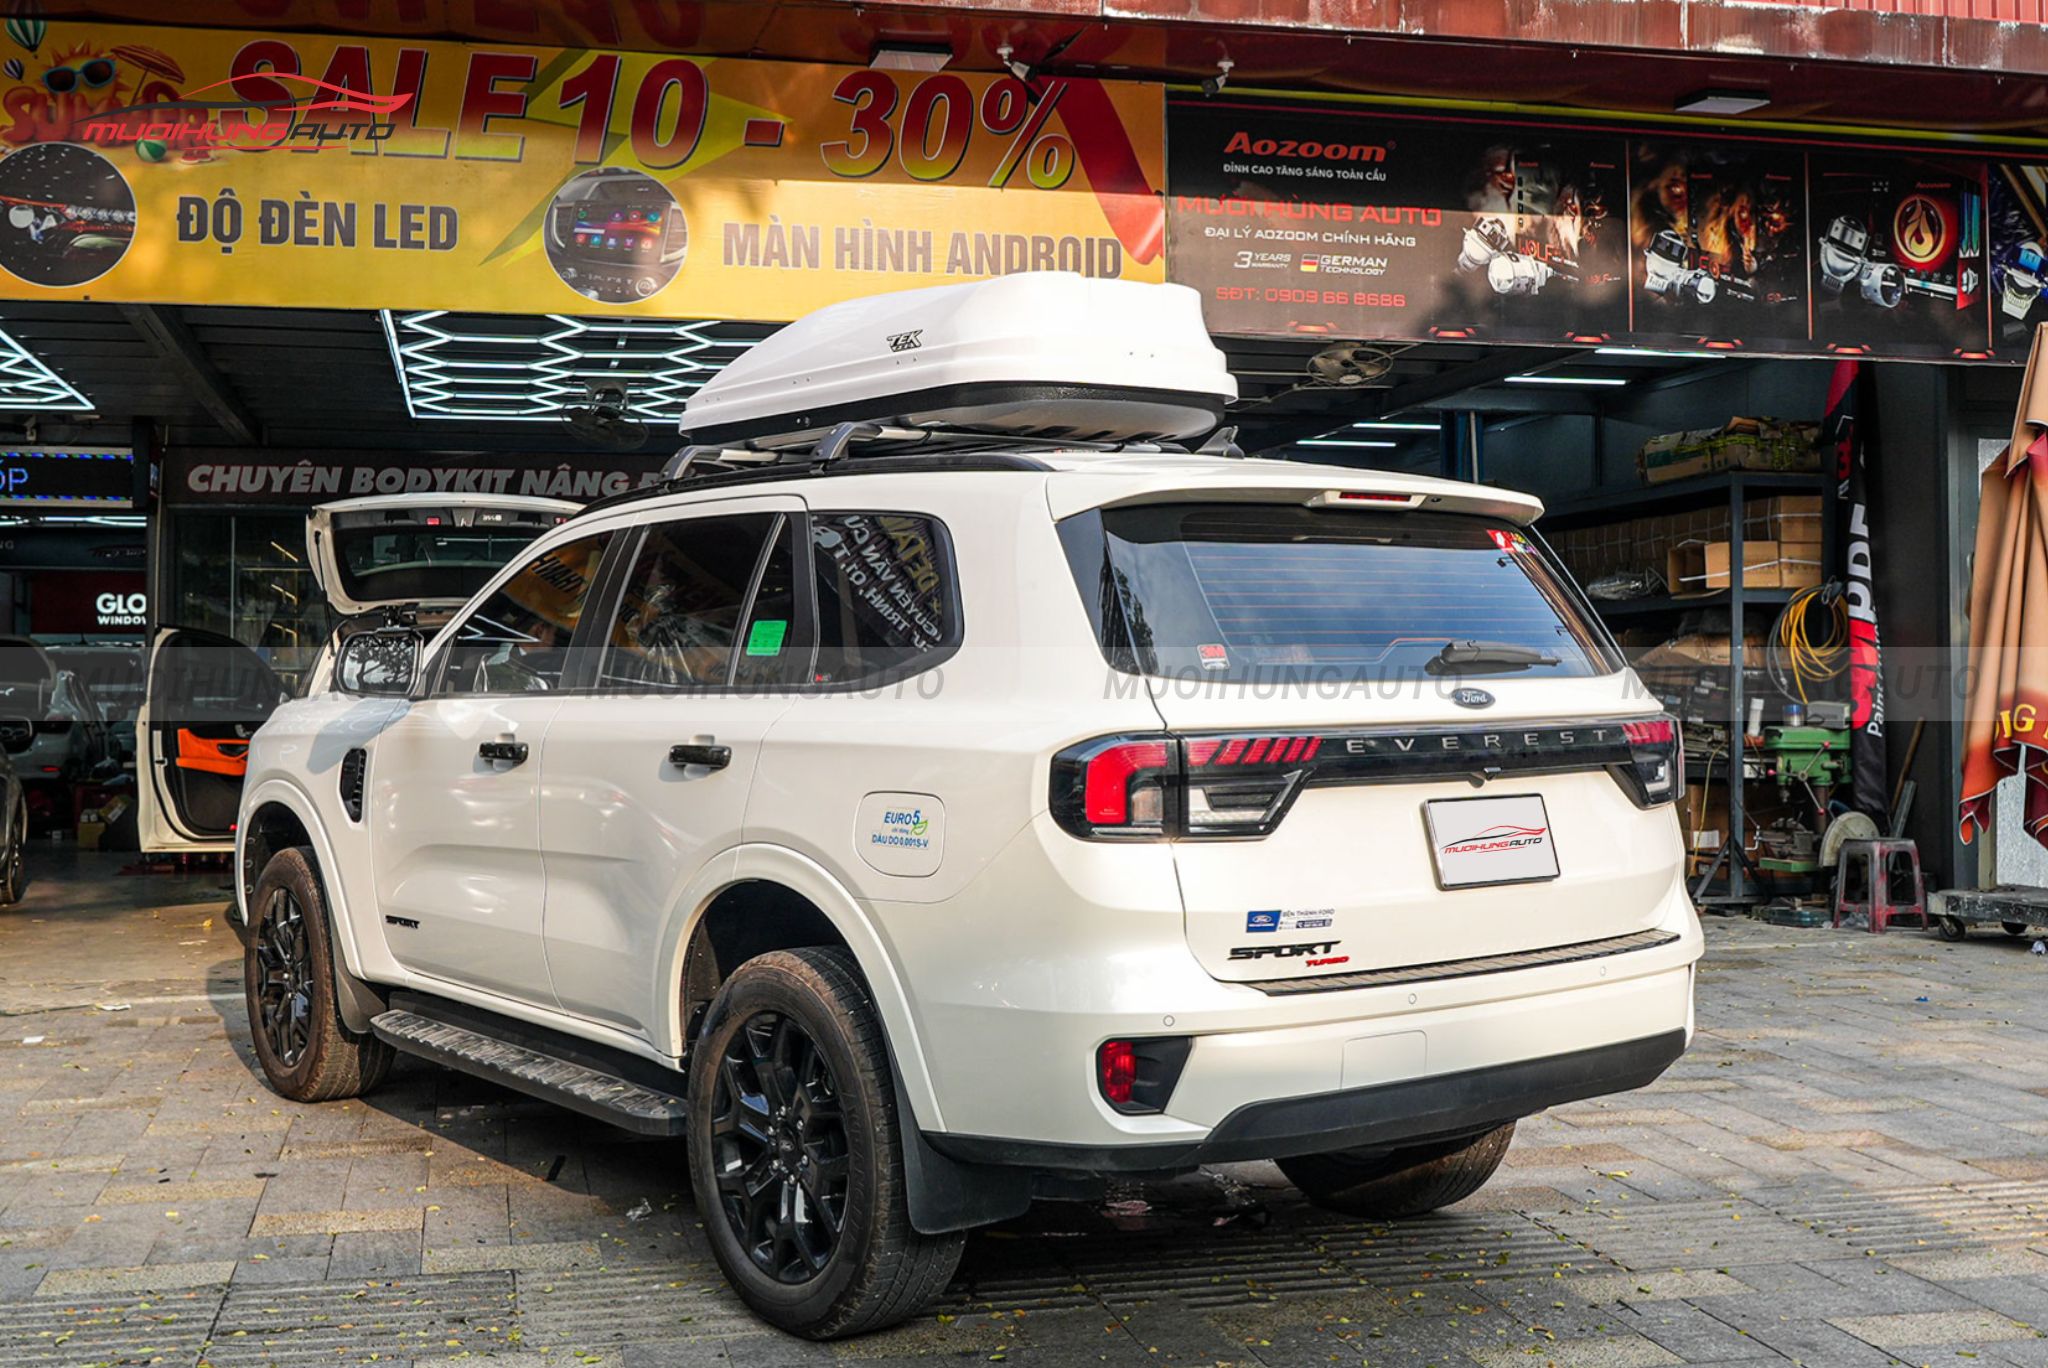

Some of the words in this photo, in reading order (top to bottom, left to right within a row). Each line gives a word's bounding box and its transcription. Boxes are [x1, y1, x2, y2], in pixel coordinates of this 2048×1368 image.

[217, 40, 537, 163] SALE
[556, 54, 710, 171] 10
[820, 70, 1076, 190] 30%
[1223, 131, 1386, 162] Aozoom
[1251, 165, 1273, 175] CAO
[1276, 164, 1303, 177] TĂNG
[1305, 164, 1334, 178] SÁNG
[1336, 167, 1364, 180] TOÀN
[176, 187, 243, 254] ĐỘ
[259, 191, 357, 249] ĐÈN
[372, 203, 459, 252] LED
[1359, 204, 1443, 226] AUTO
[1204, 227, 1230, 240] ĐẠI
[1234, 225, 1251, 239] LÝ
[1254, 230, 1319, 242] AOZOOM
[1322, 229, 1370, 245] CHÍNH
[723, 214, 820, 269] MÀN
[833, 217, 933, 275] HÌNH
[945, 231, 1123, 280] ANDROID
[1233, 251, 1253, 269] 3
[1253, 252, 1292, 263] YEARS
[1320, 253, 1388, 268] GERMAN
[1320, 265, 1386, 276] TECHNOLOGY
[1264, 288, 1319, 303] 0909
[1322, 290, 1349, 305] 66
[187, 459, 347, 493] CHUYÊN
[349, 466, 515, 495] BODYKIT
[518, 463, 630, 498] NÂNG
[1346, 726, 1608, 755] EVEREST
[1226, 940, 1341, 960] SPORT
